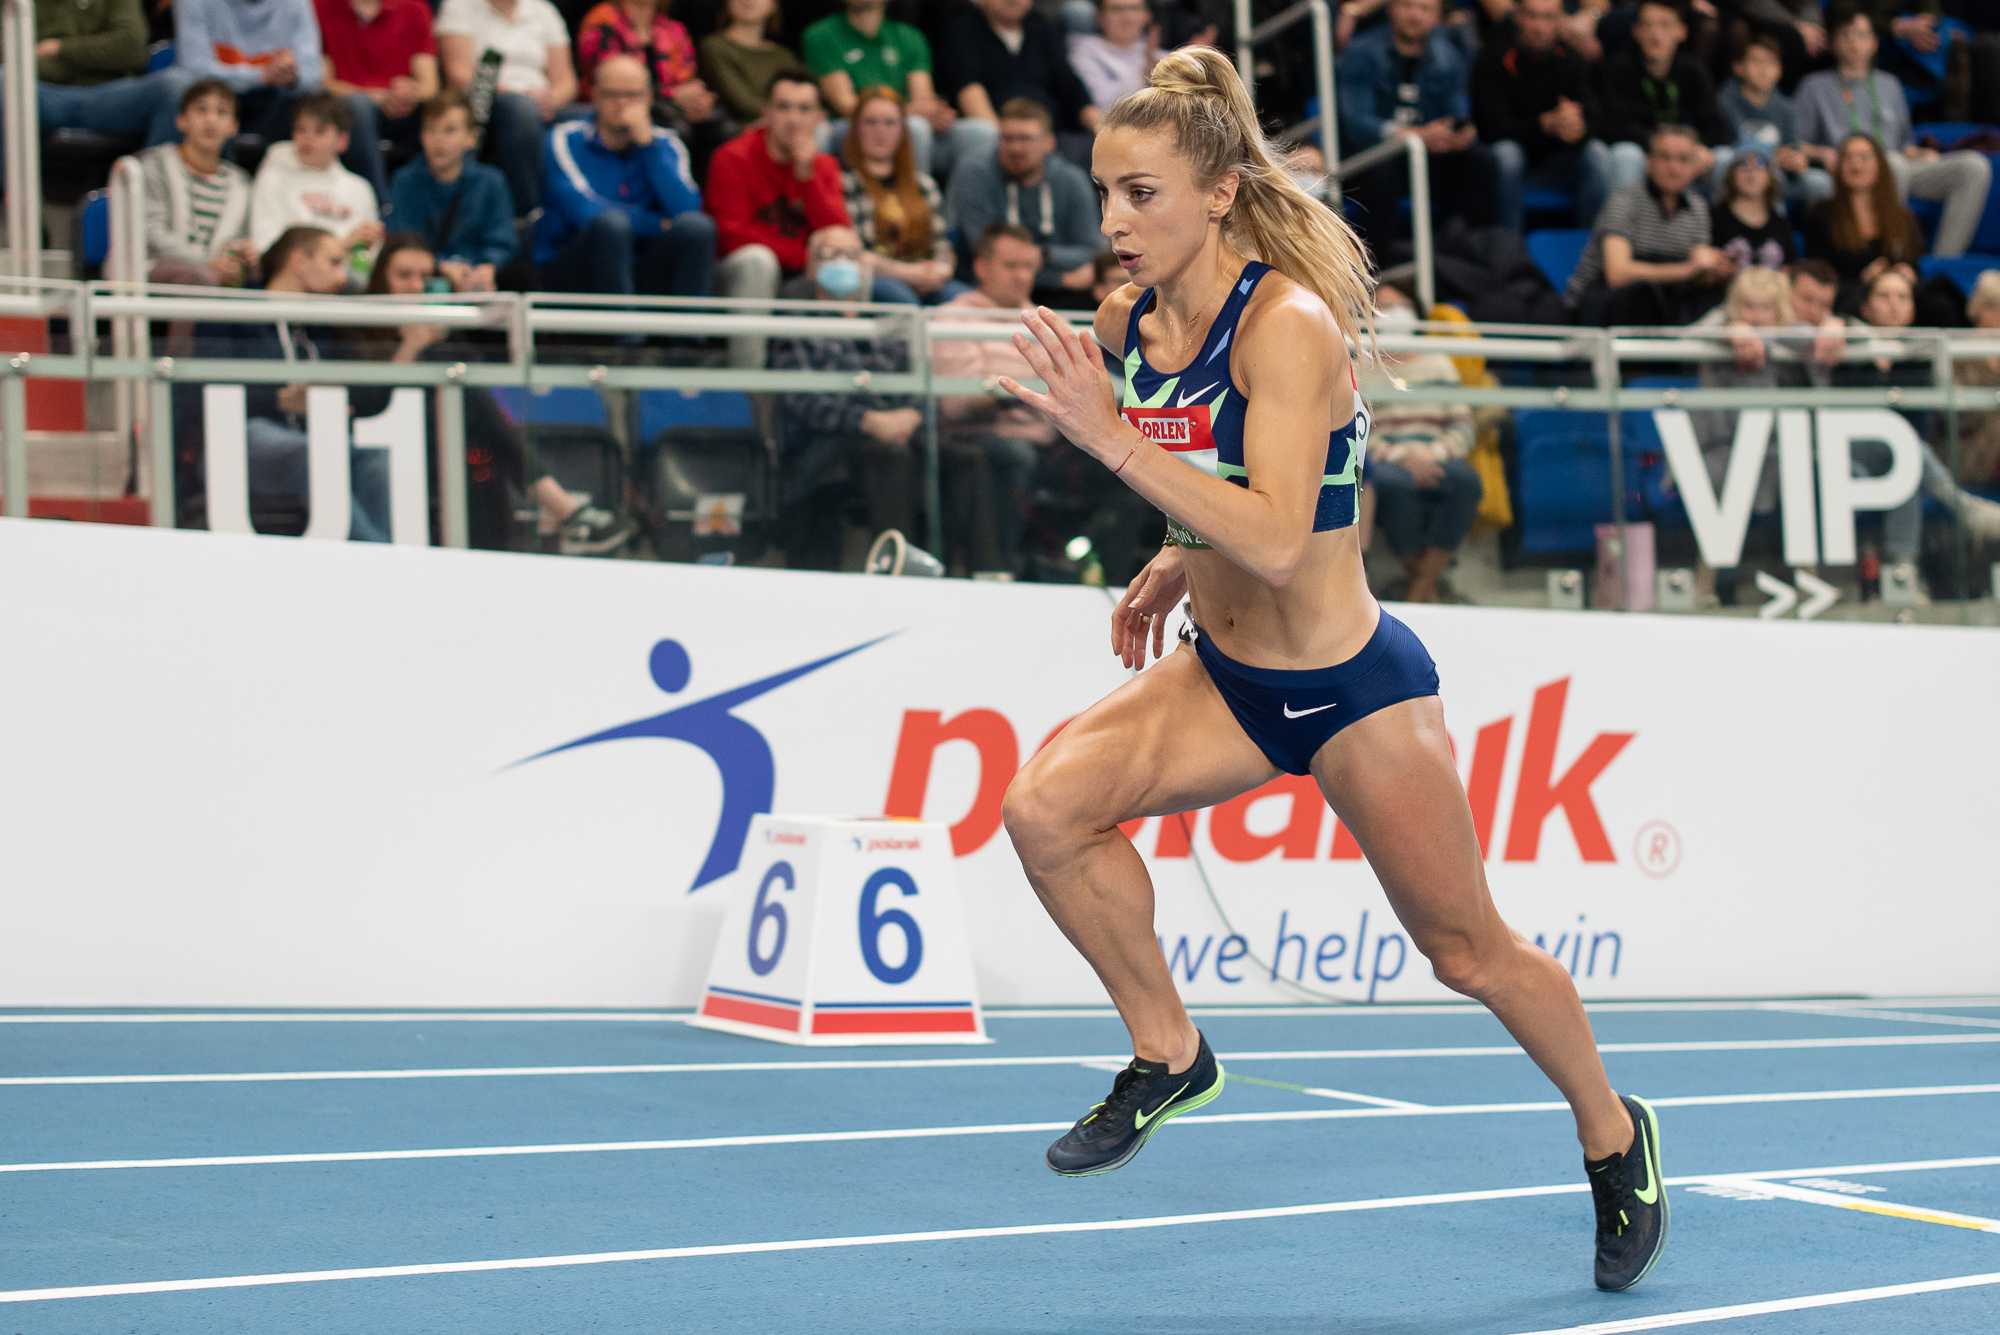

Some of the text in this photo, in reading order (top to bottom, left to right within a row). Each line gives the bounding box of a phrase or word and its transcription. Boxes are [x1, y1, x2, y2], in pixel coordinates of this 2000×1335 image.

[203, 384, 430, 546] U1
[1142, 421, 1187, 440] ORLEN
[1652, 408, 1923, 568] VIP
[748, 861, 795, 977] 6
[858, 866, 924, 985] 6
[1156, 933, 1249, 983] we
[1270, 909, 1408, 1003] help
